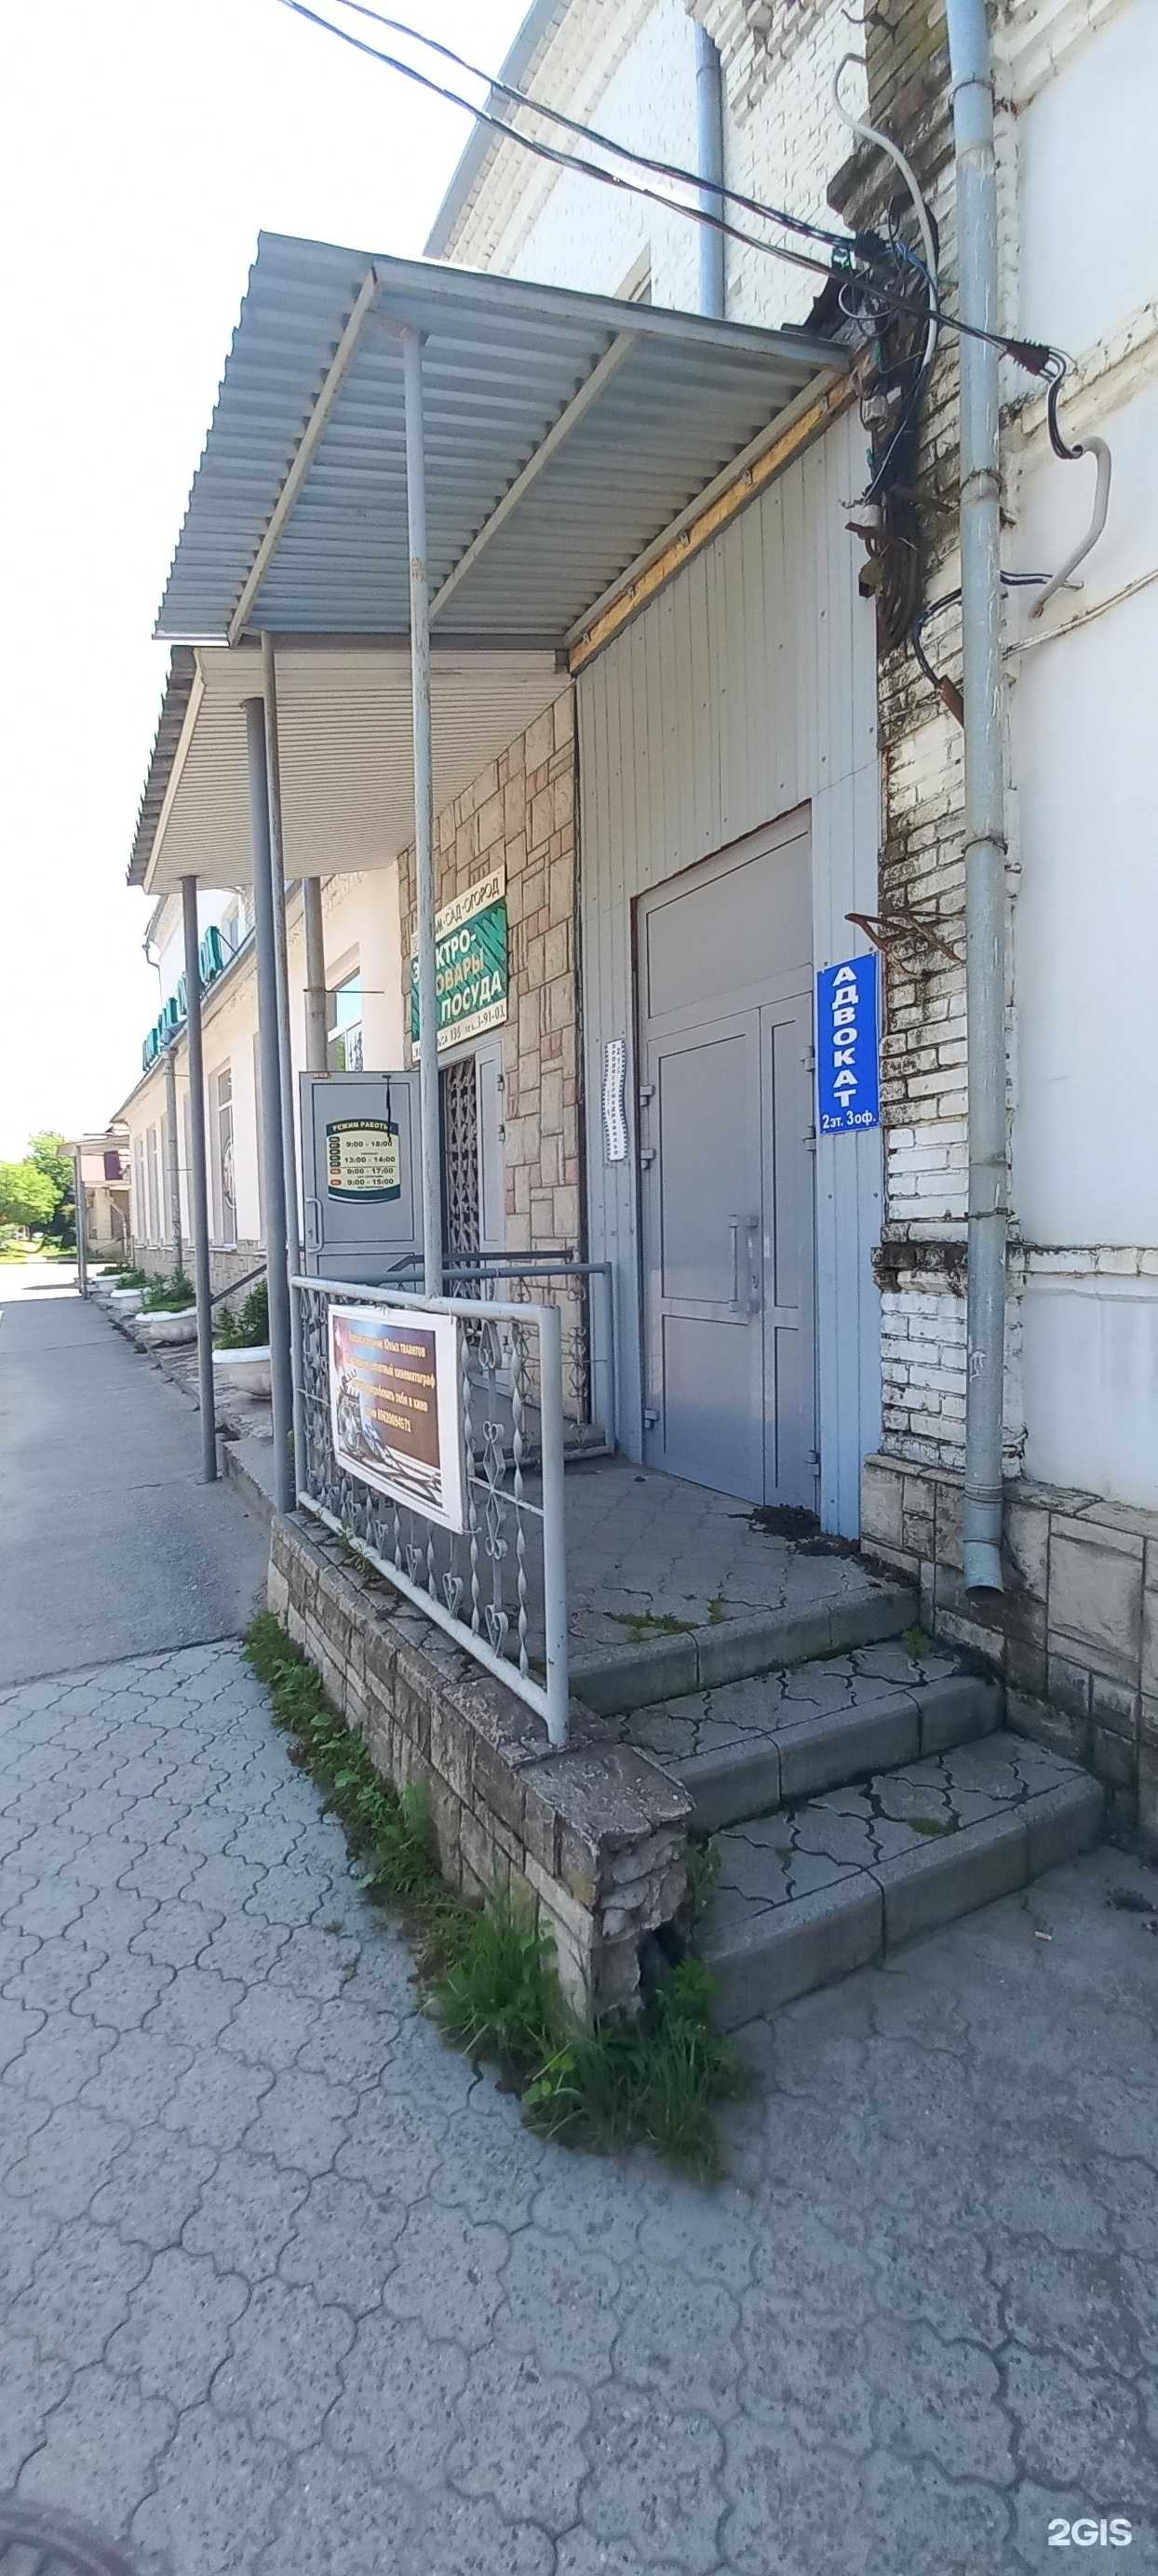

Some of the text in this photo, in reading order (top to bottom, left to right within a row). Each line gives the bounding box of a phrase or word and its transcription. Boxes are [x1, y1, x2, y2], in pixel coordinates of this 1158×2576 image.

[435, 947, 485, 996] ОВАРЫ
[440, 970, 503, 1023] ПОСУДА
[832, 966, 858, 1107] АДВОКАТ
